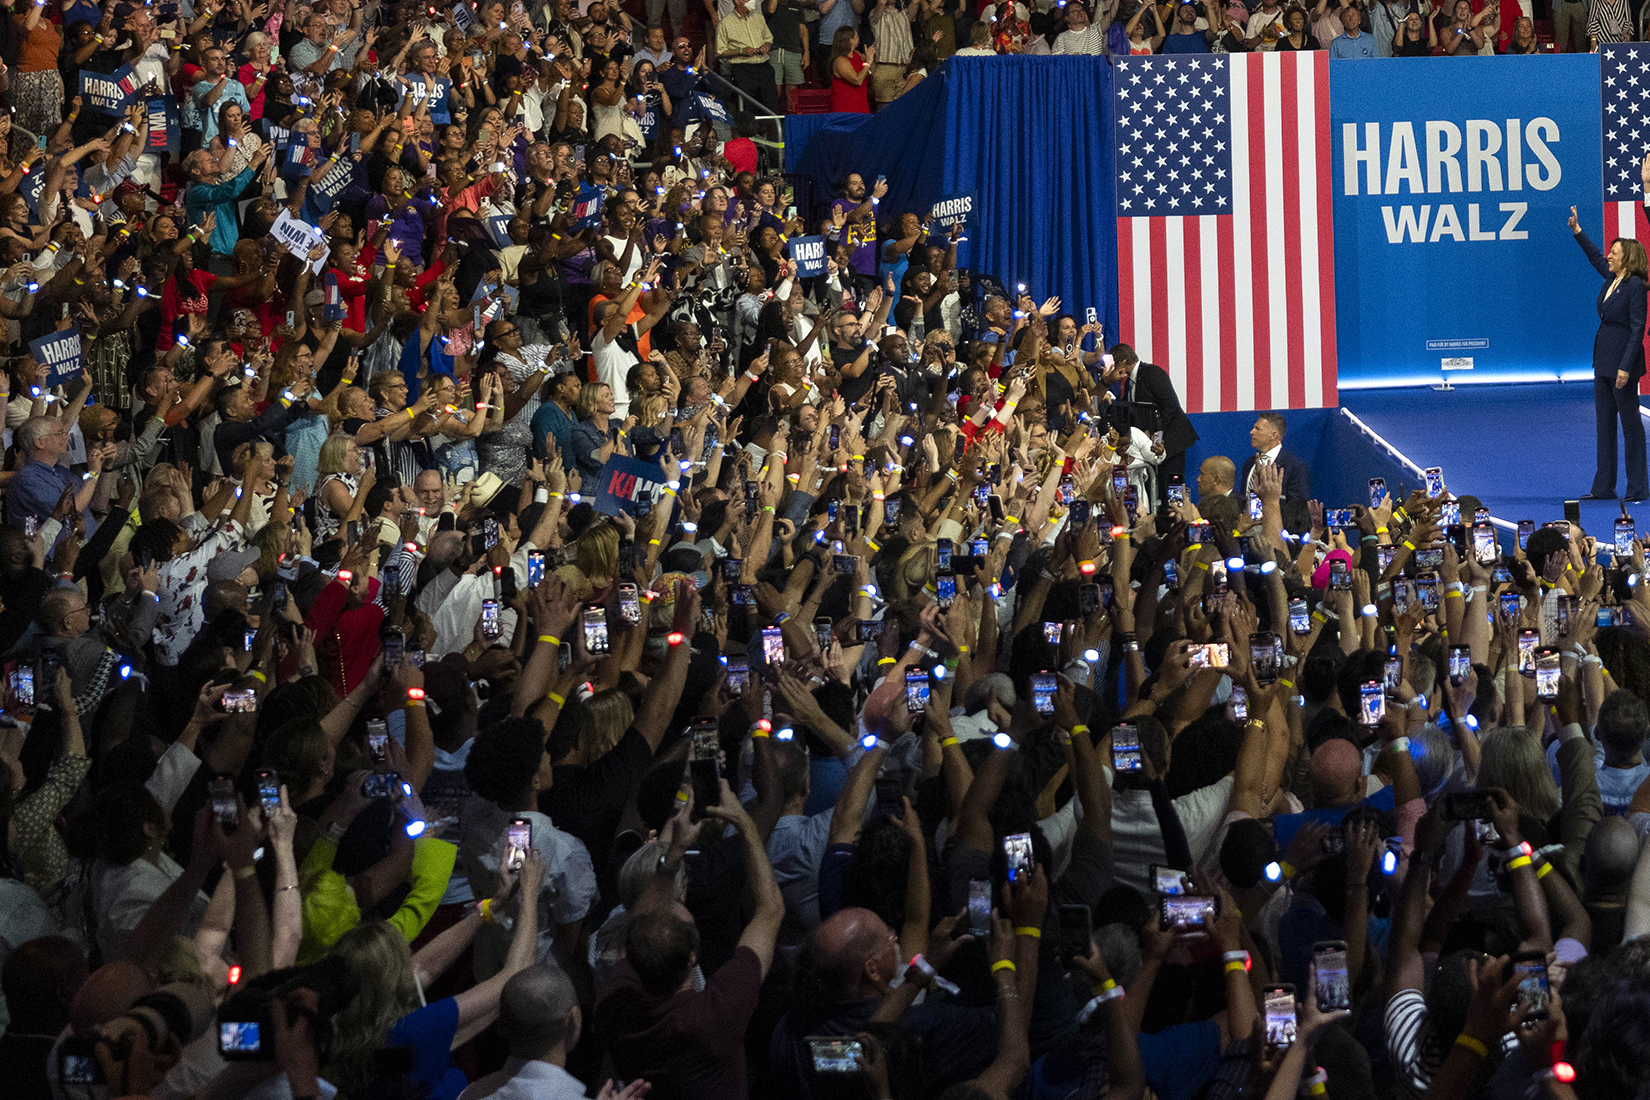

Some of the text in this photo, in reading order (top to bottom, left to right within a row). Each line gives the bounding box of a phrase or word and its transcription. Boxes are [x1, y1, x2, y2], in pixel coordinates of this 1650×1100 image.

[84, 77, 124, 101] HARRIS
[91, 95, 119, 110] WALZ
[1343, 117, 1562, 196] HARRIS
[313, 157, 354, 196] HARRIS
[325, 174, 354, 198] WALZ
[932, 196, 973, 217] HARRIS
[940, 214, 967, 228] WALZ
[1381, 202, 1528, 243] WALZ
[40, 333, 81, 364] HARRIS
[54, 355, 80, 376] WALZ
